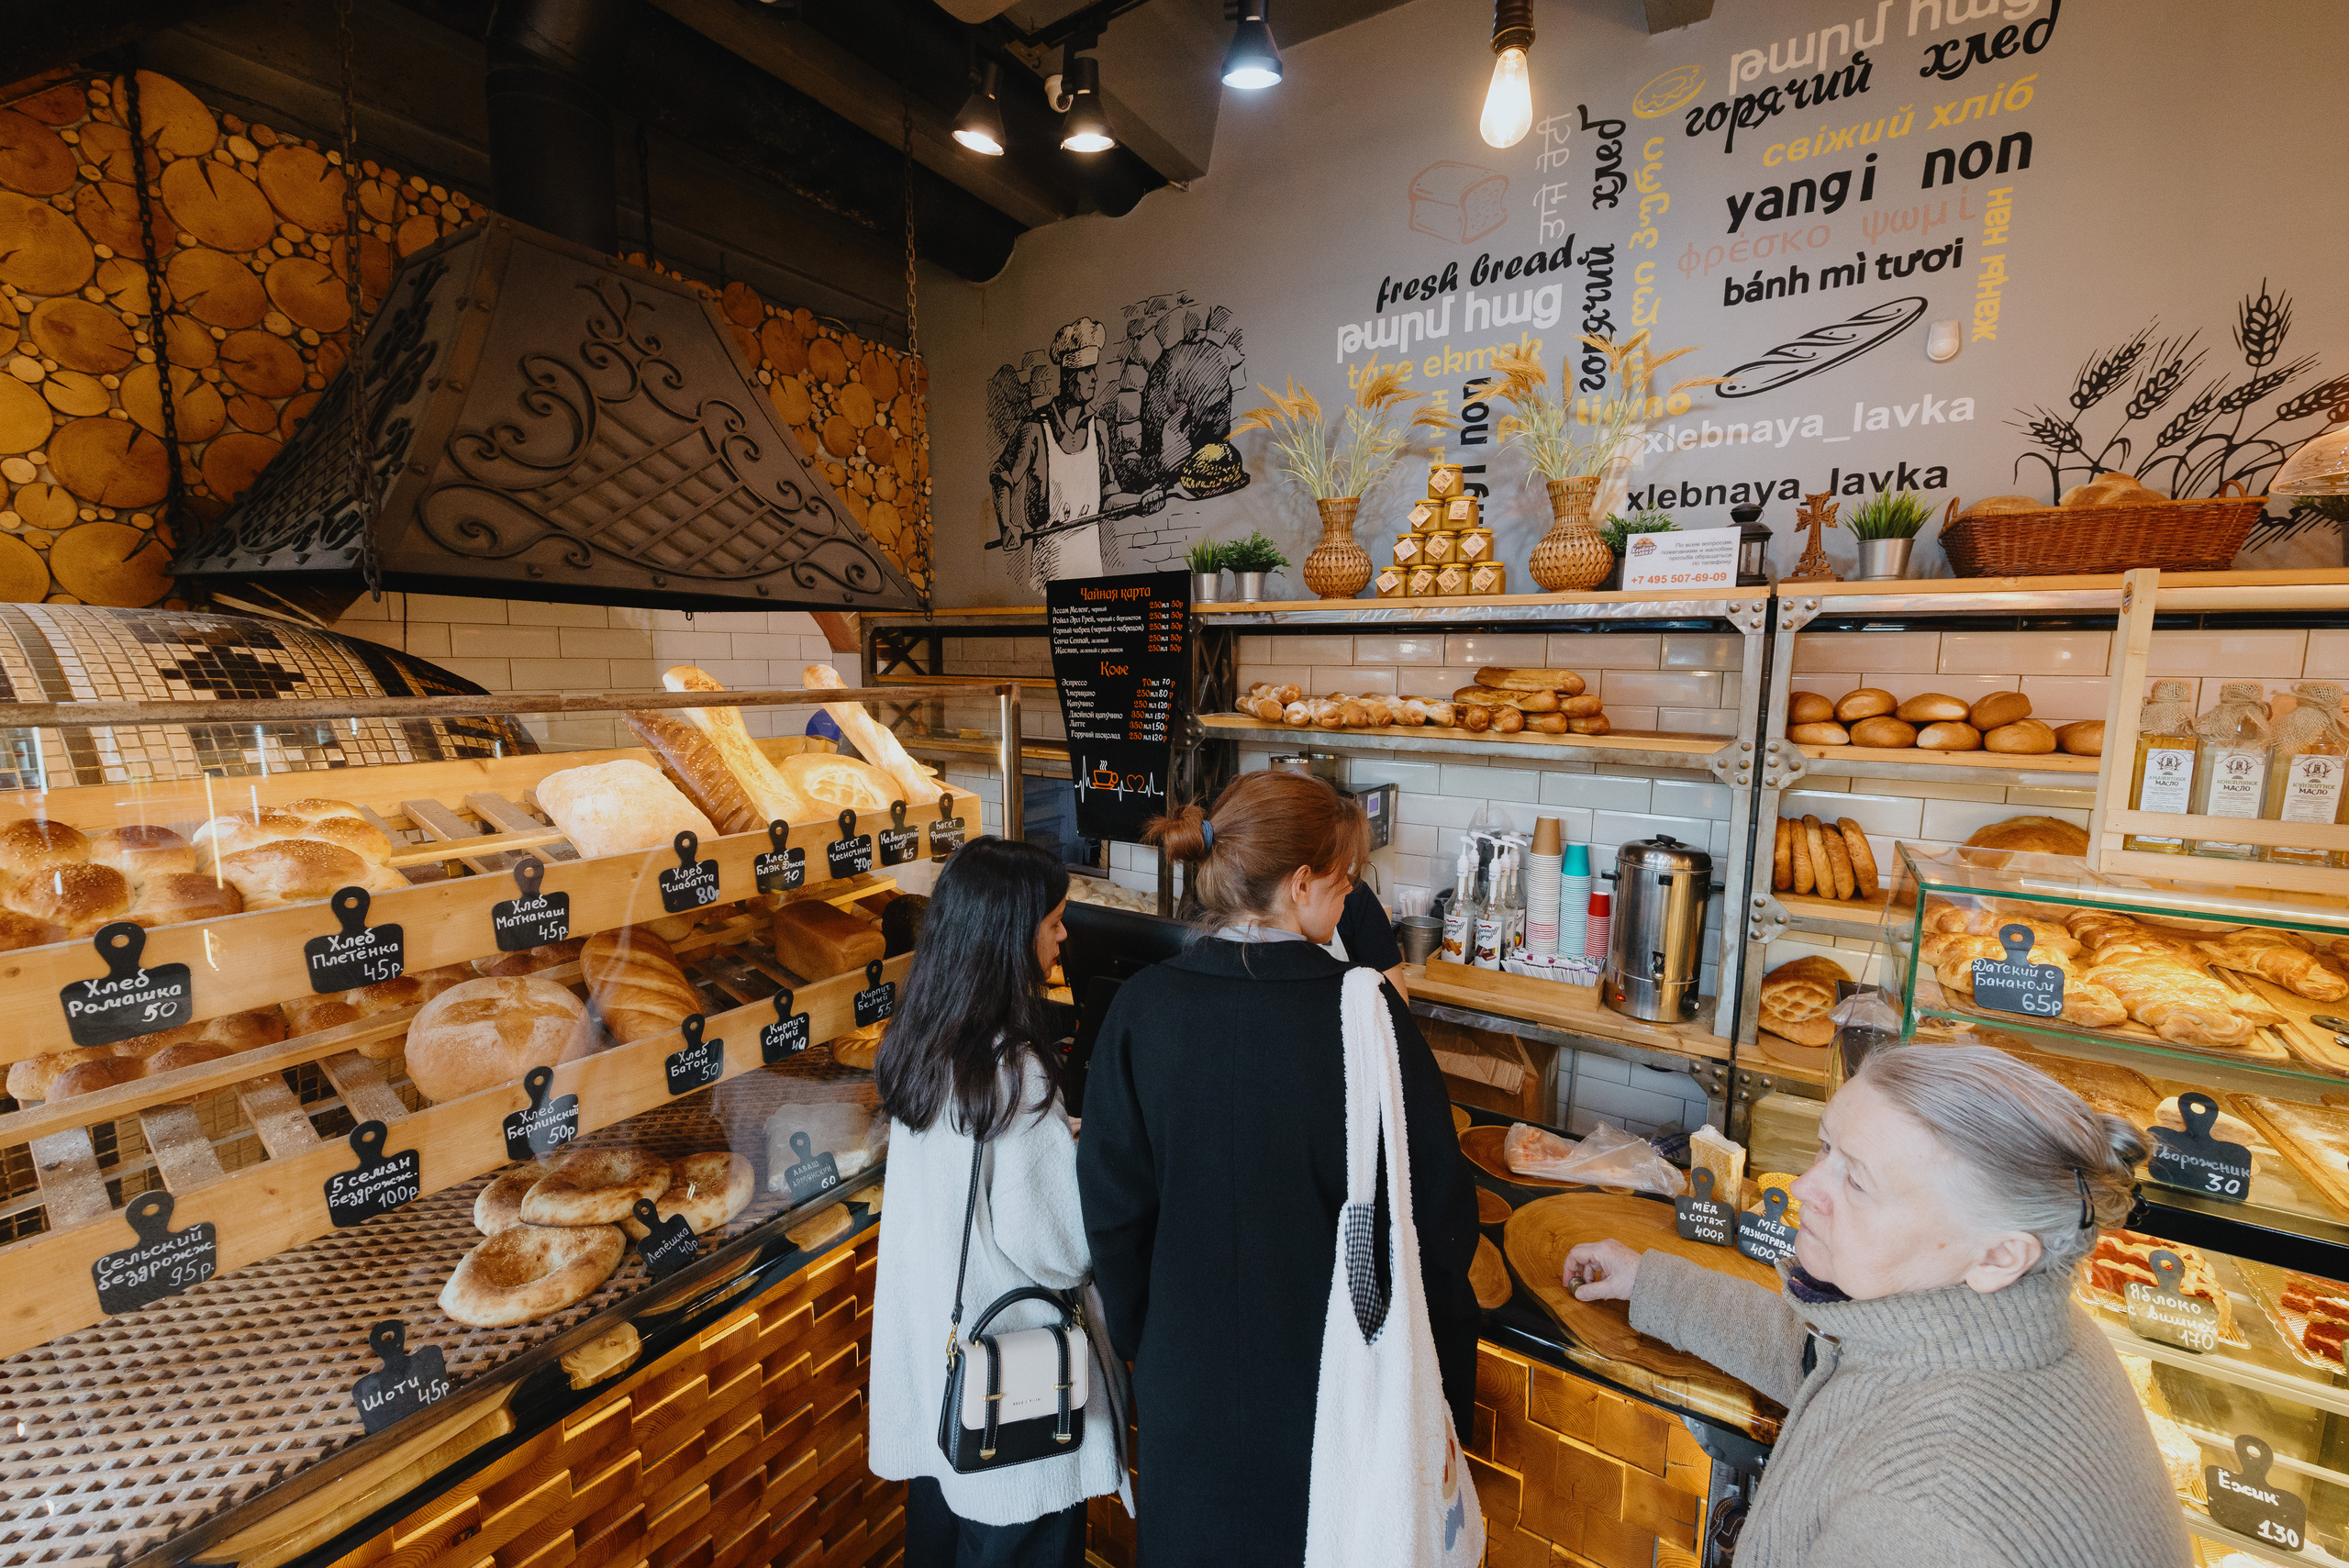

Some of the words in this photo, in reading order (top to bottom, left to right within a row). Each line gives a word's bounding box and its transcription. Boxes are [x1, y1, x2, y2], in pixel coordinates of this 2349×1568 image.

[1686, 51, 1873, 154] горячий
[1763, 104, 1915, 167] свіжий
[1927, 73, 2038, 129] хліб
[1577, 105, 1627, 210] хлеб
[1921, 131, 2032, 189] non
[1984, 186, 2013, 247] нан
[1375, 261, 1458, 314] fresh
[1469, 233, 1576, 288] bread
[1723, 265, 1809, 306] bánh
[1820, 251, 1866, 290] mì
[1876, 237, 1964, 280] tươi
[1971, 252, 2007, 343] жаңы
[1644, 394, 1975, 455] xlebnaya_lavka
[1648, 575, 1667, 584] 495
[1671, 573, 1727, 583] 507-69-09
[1081, 587, 1118, 602] Чайная
[1121, 586, 1151, 601] карта
[1101, 662, 1129, 677] Кофе
[1062, 678, 1087, 687] Эспрессо
[936, 819, 957, 829] Багет
[835, 838, 859, 851] Багет
[903, 848, 914, 860] 45
[765, 849, 789, 864] Хлеб
[673, 862, 703, 880] Хлеб
[757, 862, 780, 875] Блэк
[784, 870, 799, 884] 70
[512, 895, 548, 914] Хлеб
[496, 907, 565, 929] Матнакаш
[328, 929, 376, 951] Хлеб
[312, 941, 399, 969] Плетёнка
[1972, 958, 2039, 978] Датский
[84, 969, 150, 998] Хлеб
[861, 984, 890, 1000] Кирпич
[1976, 973, 2054, 993] Бананом
[69, 983, 182, 1018] Ромашка
[857, 993, 888, 1011] Белый
[877, 1001, 893, 1018] 55
[2022, 994, 2063, 1016] 65р
[141, 1002, 177, 1022] 50
[770, 1017, 805, 1035] Кирпич
[765, 1027, 798, 1046] Серый
[678, 1042, 709, 1063] Хлеб
[671, 1059, 707, 1076] Батон
[701, 1062, 718, 1081] 50
[507, 1104, 579, 1140] Берлинский
[519, 1101, 554, 1125] Хлеб
[548, 1126, 576, 1144] 50р
[794, 1160, 819, 1175] ЛАВАШ
[2151, 1141, 2251, 1178] Творожник
[332, 1176, 344, 1194] 5
[349, 1156, 410, 1184] семян
[793, 1165, 832, 1187] АРМЯНСКИЙ
[821, 1175, 836, 1188] 60
[2205, 1173, 2241, 1195] 30
[1693, 1202, 1718, 1215] МЁД
[1689, 1214, 1726, 1226] СОТАХ
[1758, 1219, 1786, 1236] МЁД
[97, 1225, 202, 1274] Сельский
[647, 1227, 689, 1263] Лепёшка
[679, 1239, 698, 1254] 40р
[2131, 1283, 2201, 1314] Яблоко
[2180, 1329, 2214, 1351] 170
[418, 1379, 450, 1405] 45р
[2218, 1468, 2279, 1507] Ёжик
[2257, 1519, 2299, 1548] 130
